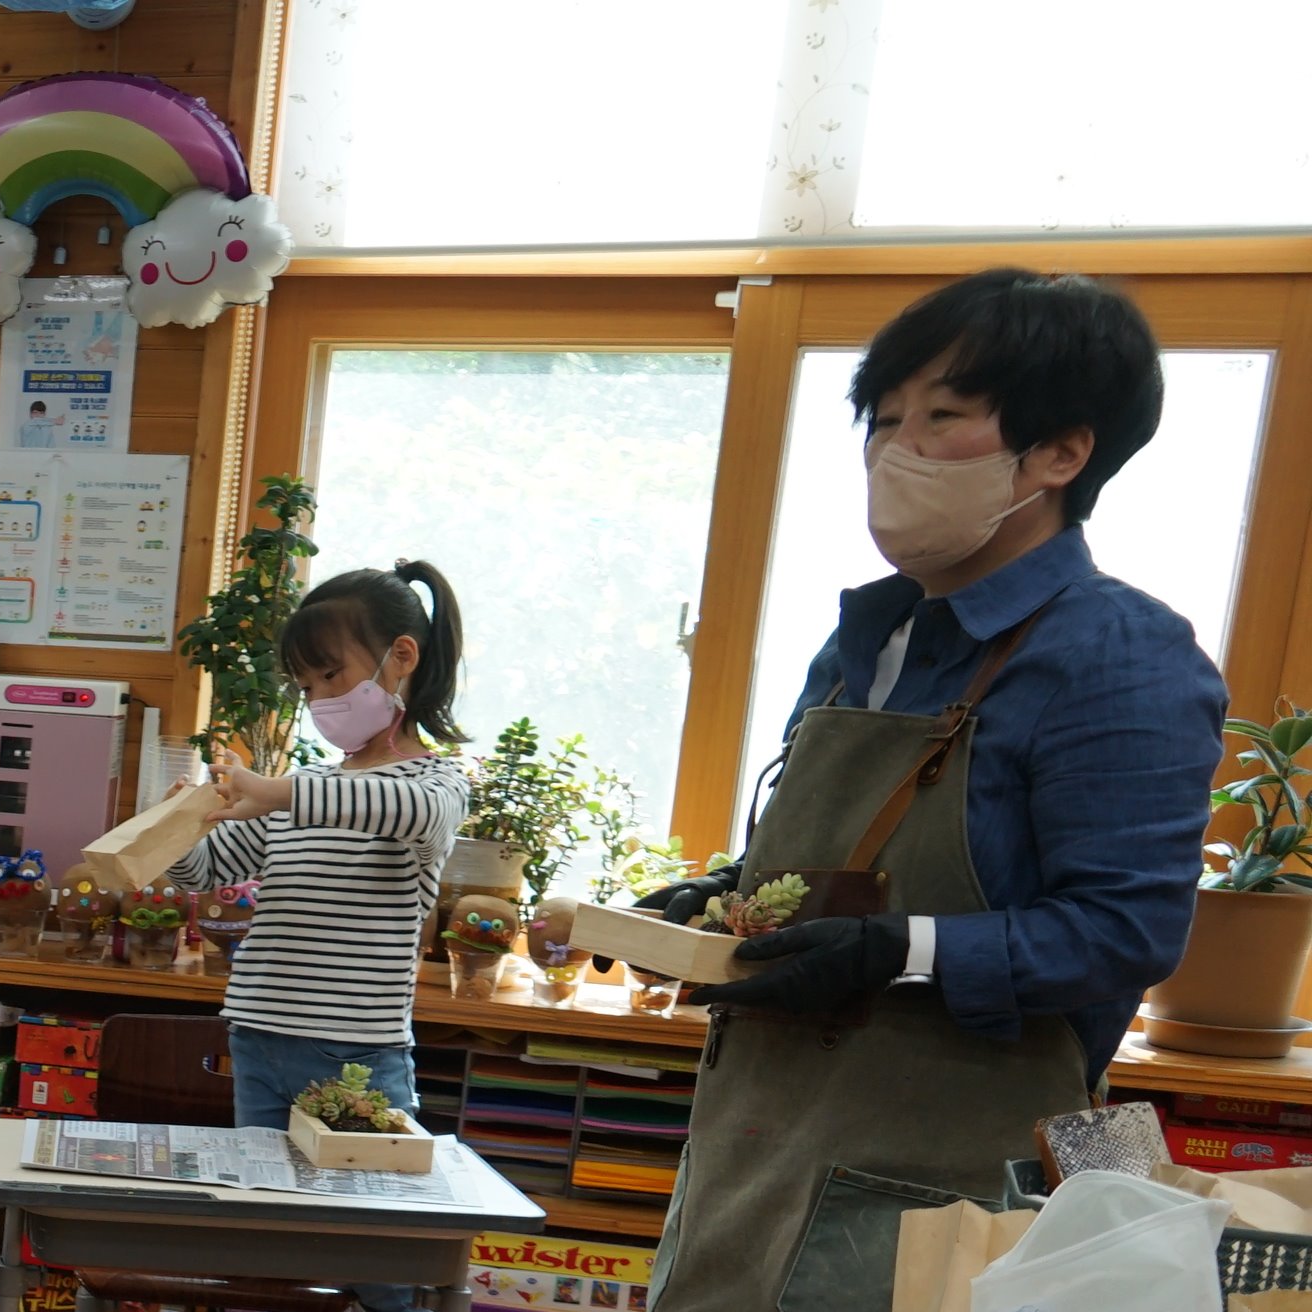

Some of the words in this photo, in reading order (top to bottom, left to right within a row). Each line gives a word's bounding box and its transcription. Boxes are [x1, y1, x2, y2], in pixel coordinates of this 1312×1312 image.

[1220, 1100, 1276, 1116] GALLI
[1185, 1137, 1228, 1149] HALLI
[1184, 1146, 1227, 1159] GALLI
